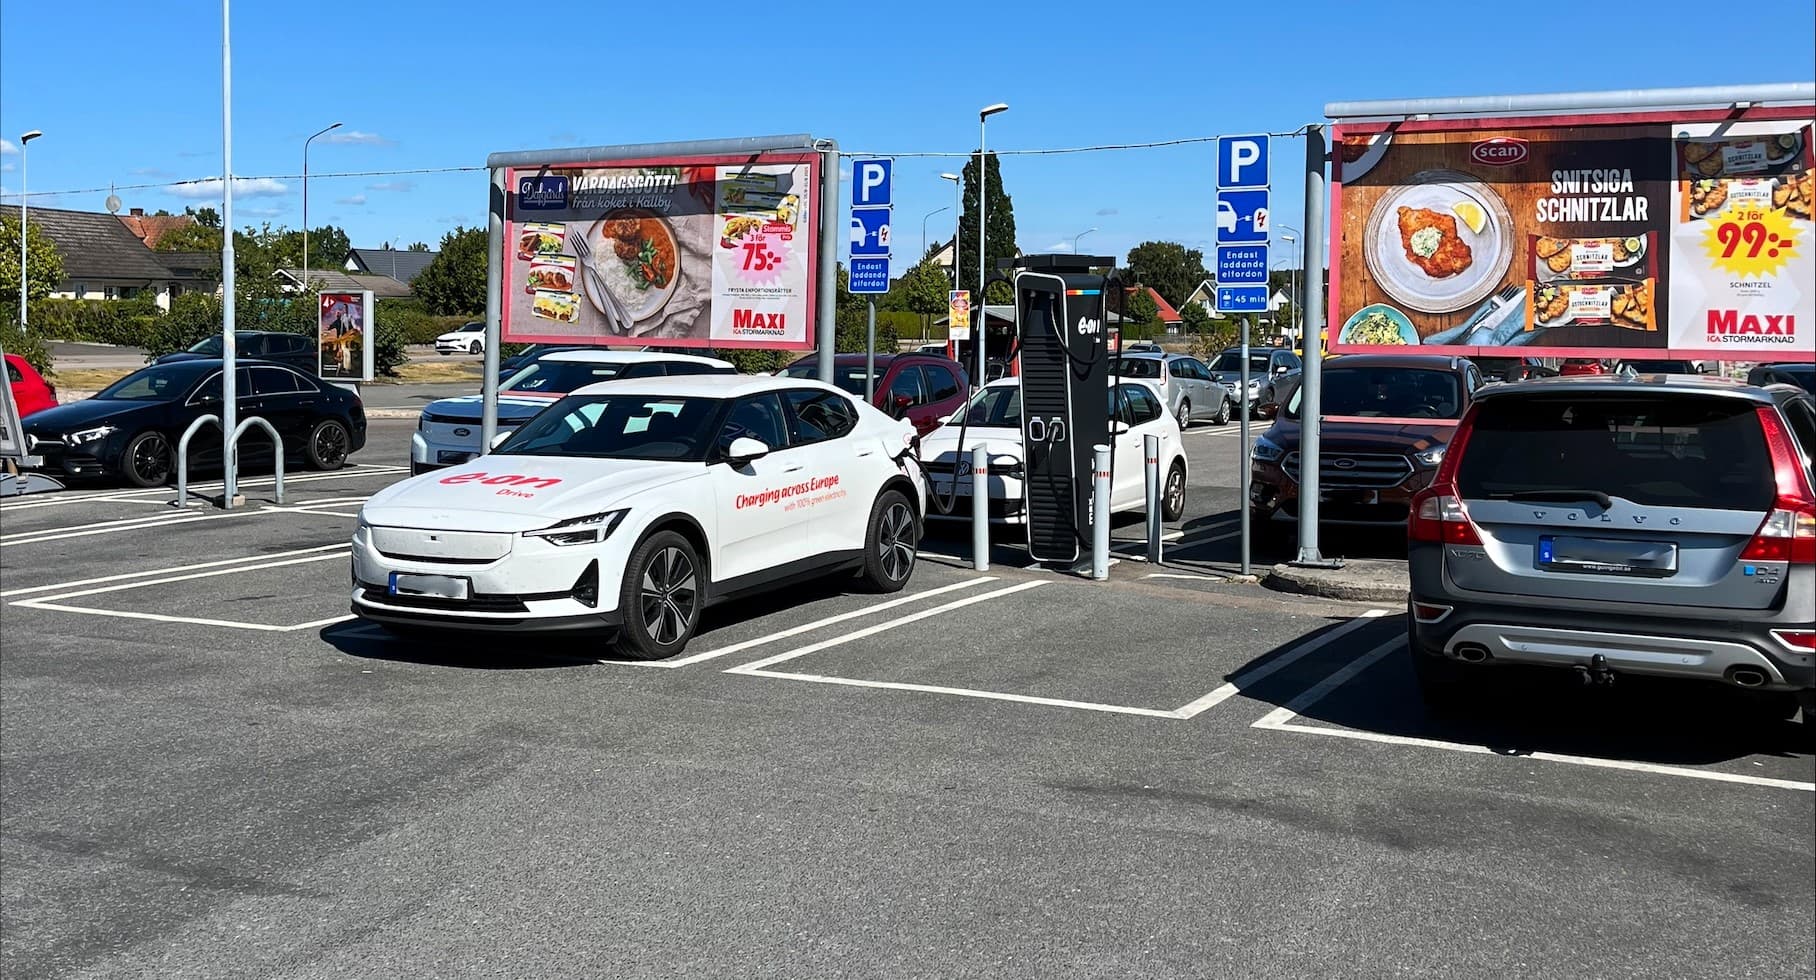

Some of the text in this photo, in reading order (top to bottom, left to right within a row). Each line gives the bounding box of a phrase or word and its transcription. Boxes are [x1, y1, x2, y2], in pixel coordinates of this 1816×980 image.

[1480, 144, 1518, 157] scan
[1231, 140, 1260, 183] P
[572, 171, 676, 194] VARDAGSGÖTT!
[862, 163, 885, 202] P
[1551, 168, 1634, 194] SNITSIGA
[572, 197, 595, 209] från
[1535, 196, 1649, 223] SCHNITZLAR
[1737, 210, 1764, 220] 2 för
[1717, 221, 1793, 258] 99:-
[743, 243, 782, 271] 75:-
[1226, 251, 1258, 259] Endast
[1220, 260, 1264, 269] laddande
[852, 271, 886, 279] laddande
[1222, 270, 1263, 278] elfordon
[1235, 295, 1266, 303] 45 min
[733, 309, 785, 329] MAXI
[1707, 309, 1795, 335] MAXI
[1722, 335, 1795, 344] STORMARKNAD
[496, 488, 534, 498] Drive
[736, 474, 839, 509] Charging across Europe
[1533, 510, 1684, 527] VOLVO
